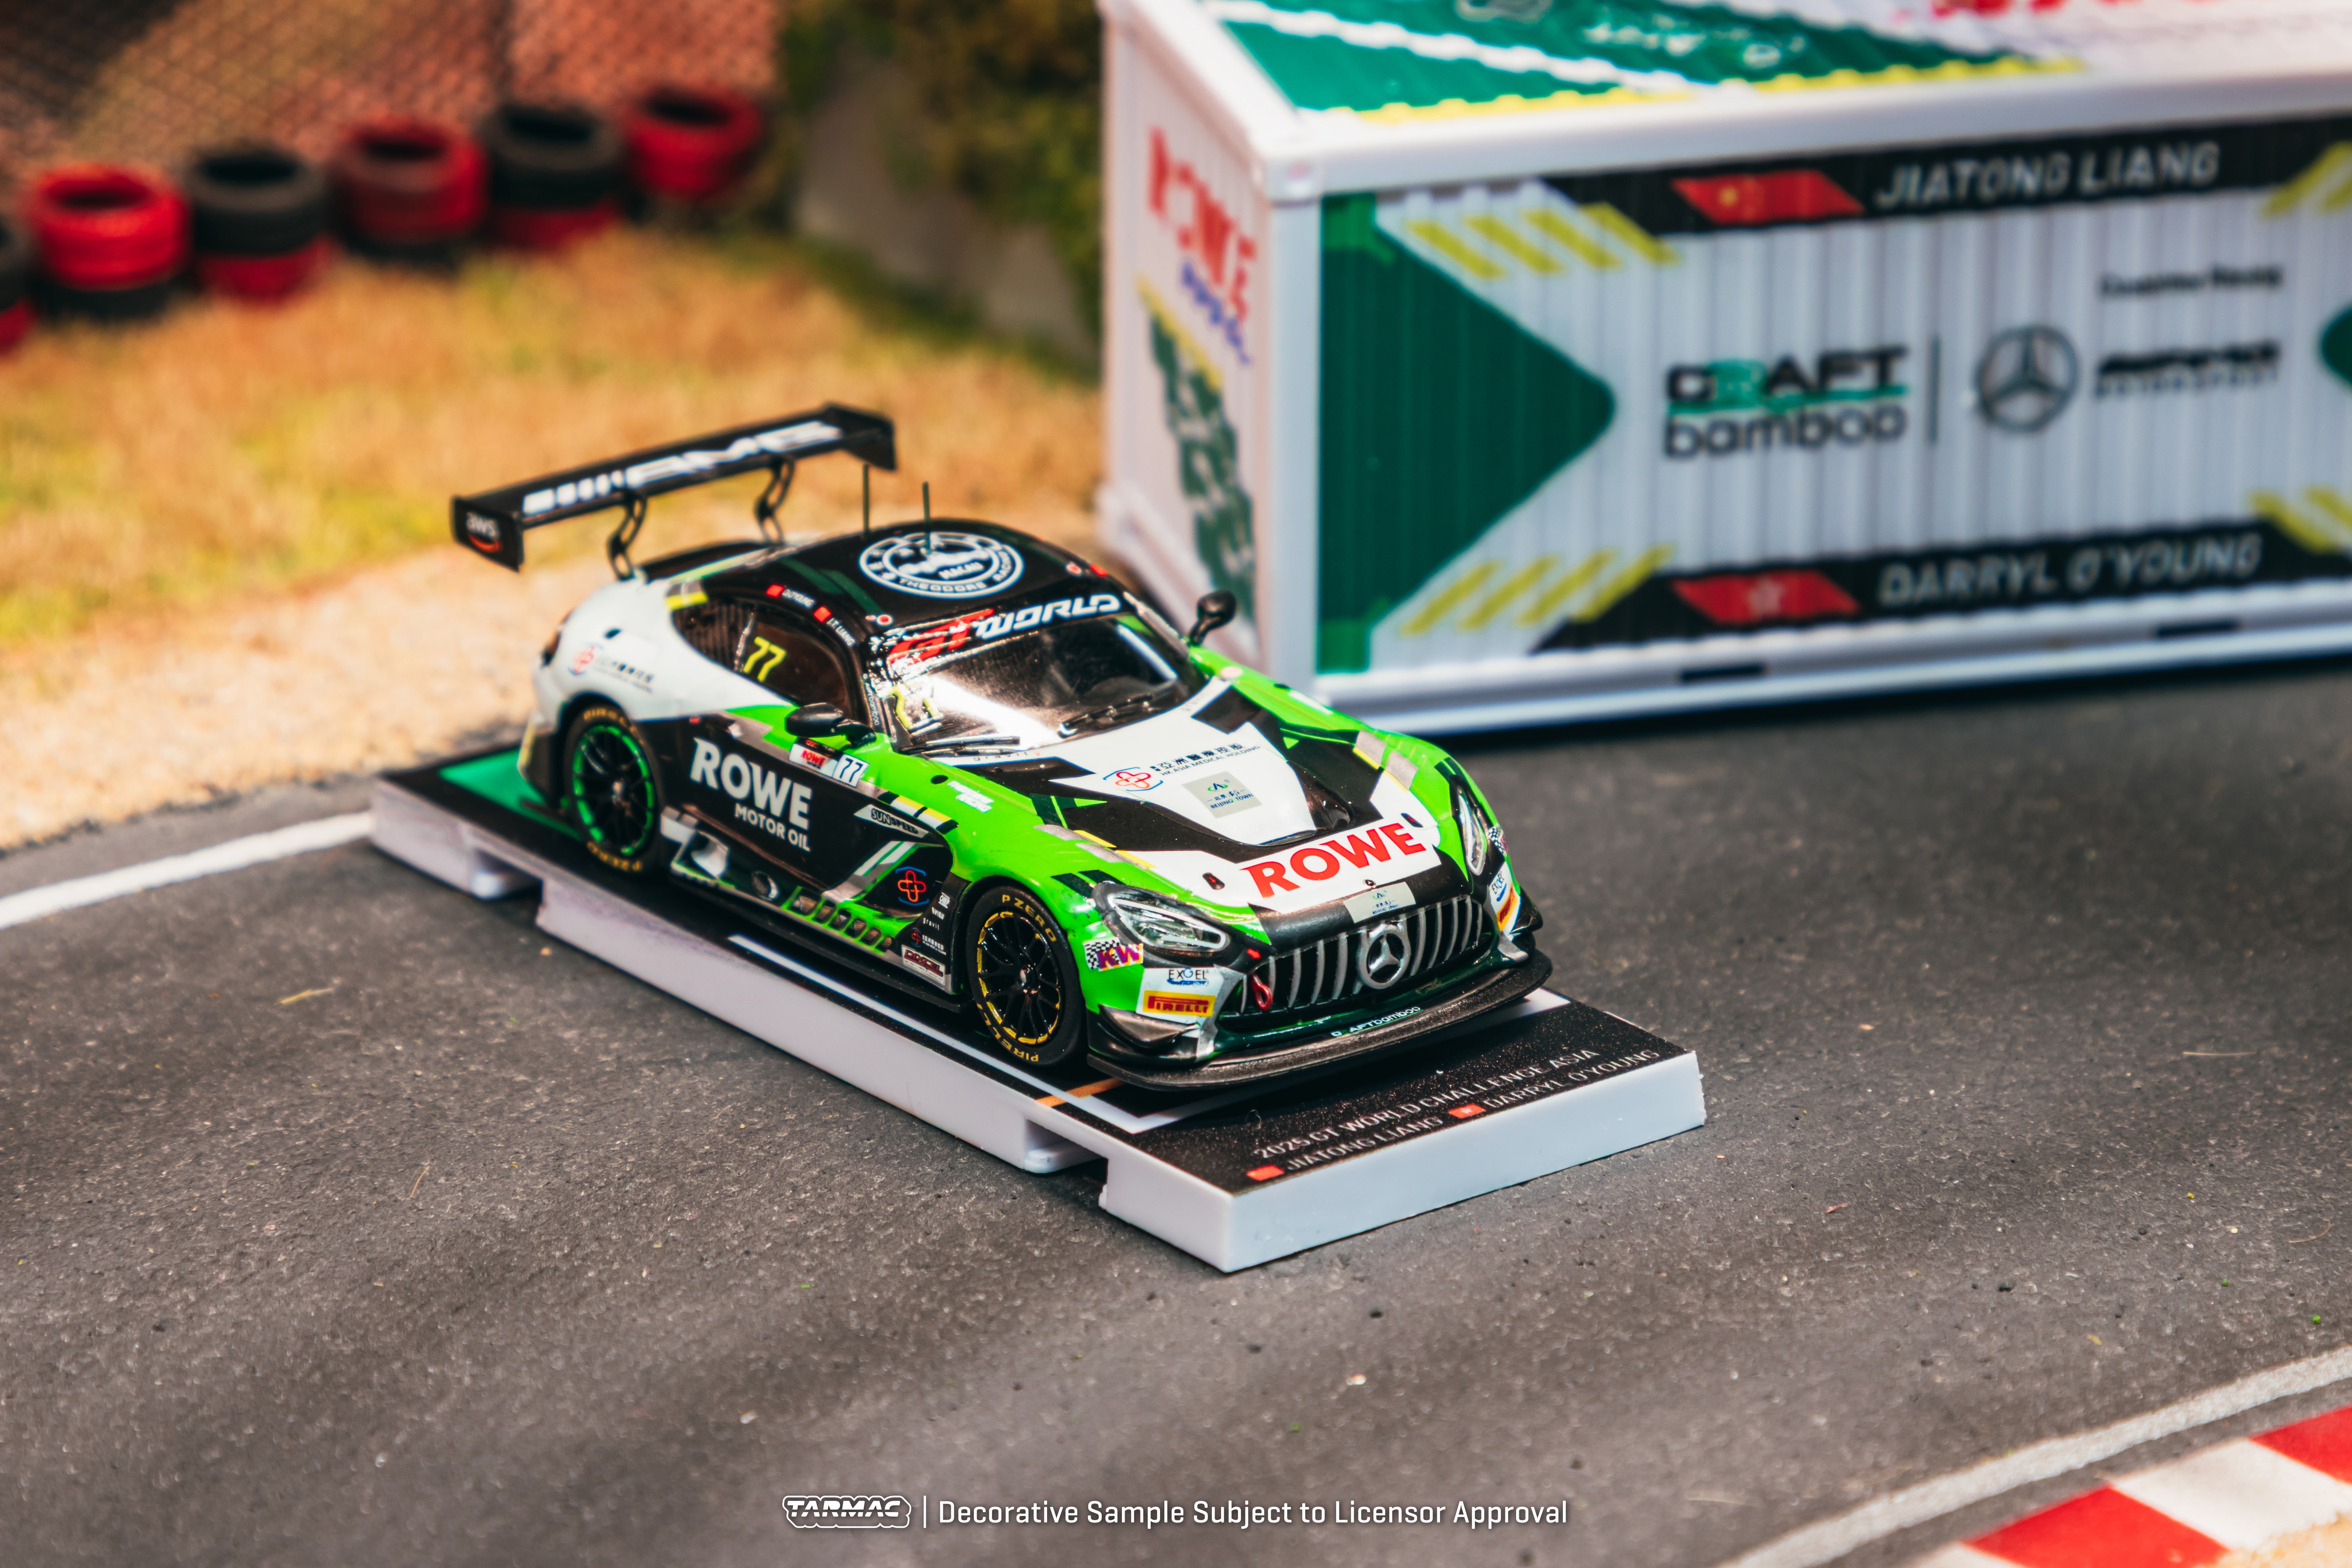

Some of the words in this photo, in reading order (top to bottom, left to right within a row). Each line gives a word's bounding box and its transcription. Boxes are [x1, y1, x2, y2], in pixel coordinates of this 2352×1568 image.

[1874, 152, 2070, 209] JIATONG
[2076, 140, 2220, 196] LIANG
[1664, 402, 1907, 459] bamboo
[899, 578, 987, 592] THEODORE
[938, 561, 984, 580] MACAU
[1877, 551, 2058, 607] DARRYL
[2066, 533, 2262, 591] O'YOUNG
[972, 593, 1120, 639] WORLD
[743, 636, 786, 682] 77
[839, 757, 864, 783] 77
[1190, 755, 1225, 767] MEDICAL
[1225, 745, 1260, 757] HOLDING
[690, 737, 812, 830] ROWE
[1210, 799, 1234, 809] BEIJING
[734, 803, 785, 840] MOTOR
[788, 830, 811, 853] OIL
[1239, 822, 1427, 898] ROWE
[904, 949, 941, 973] DIXCEL
[1097, 943, 1143, 971] KW
[1169, 967, 1207, 979] EXGEL
[1147, 996, 1209, 1013] PIRELLI
[1482, 1079, 1571, 1108] DARRYL
[1568, 1049, 1660, 1081] O'YOUNG
[1254, 1139, 1310, 1159] 2025
[1309, 1127, 1339, 1141] GT
[1338, 1104, 1421, 1132] WORLD
[1419, 1064, 1547, 1108] CHALLENGE
[1549, 1049, 1600, 1068] ASIA
[1287, 1138, 1376, 1171] JIATONG
[1374, 1116, 1443, 1141] LIANG
